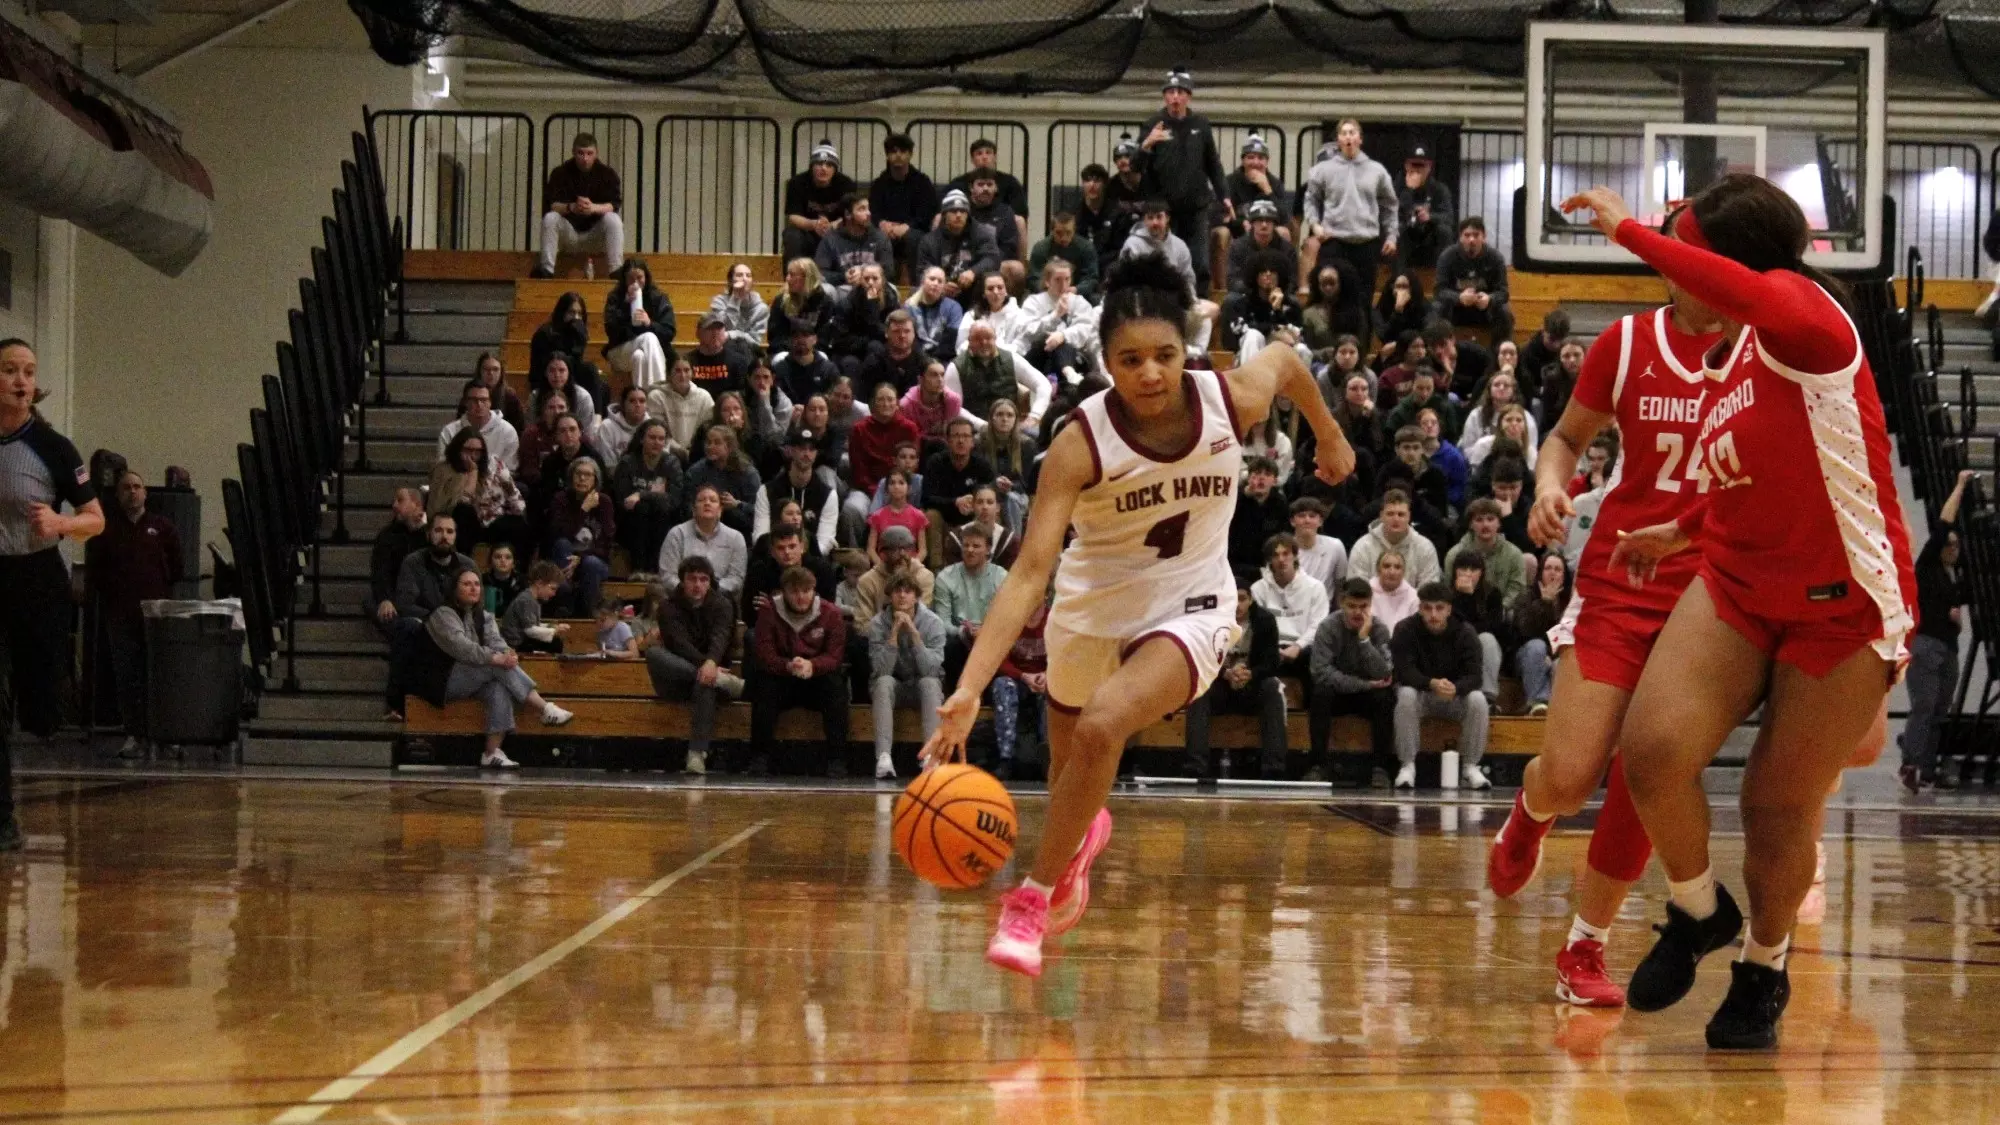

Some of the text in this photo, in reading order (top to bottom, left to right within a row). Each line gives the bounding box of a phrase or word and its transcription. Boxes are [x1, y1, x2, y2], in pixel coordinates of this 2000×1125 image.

[1639, 396, 1699, 423] EDINB
[1655, 432, 1713, 494] 24
[1115, 476, 1232, 513] LOCK HAVEN
[1144, 510, 1190, 559] 4
